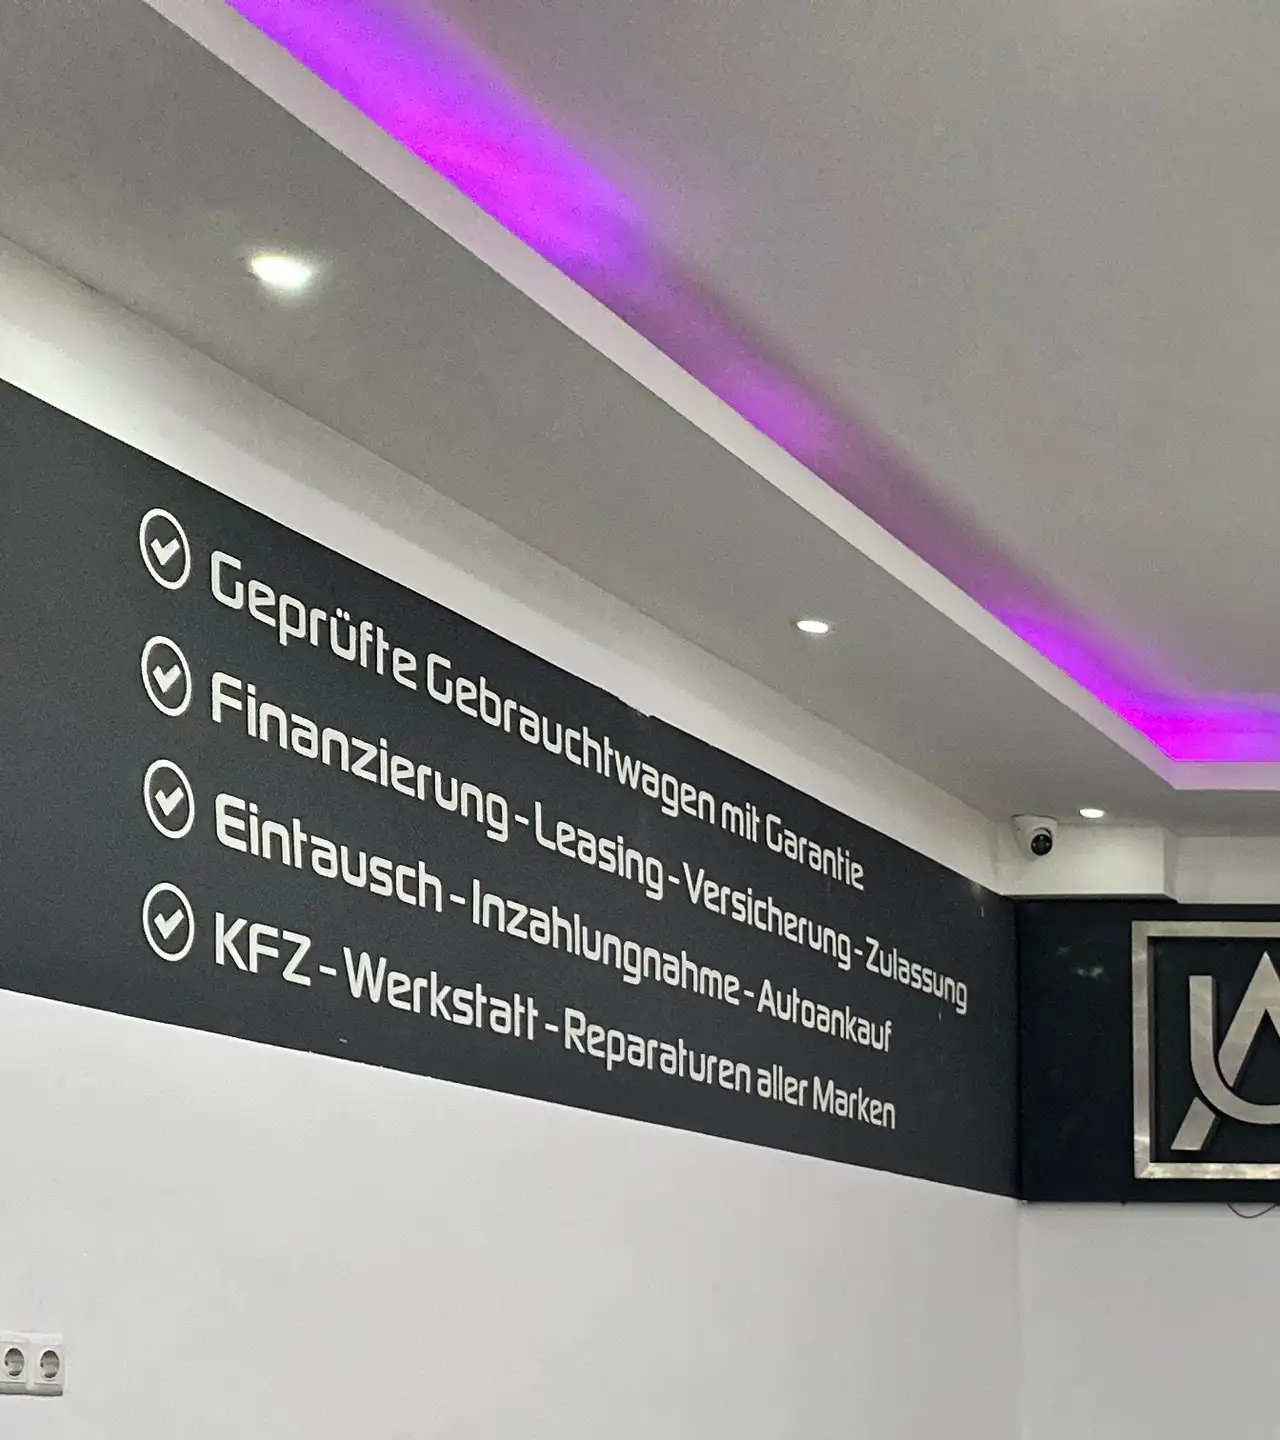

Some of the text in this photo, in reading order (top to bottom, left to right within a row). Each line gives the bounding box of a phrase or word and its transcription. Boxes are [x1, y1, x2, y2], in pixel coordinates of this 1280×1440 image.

[211, 551, 864, 891] Geprüfte Gebrauchtwagen mit Garantie
[757, 1065, 809, 1107] aller
[813, 1076, 896, 1129] Marken
